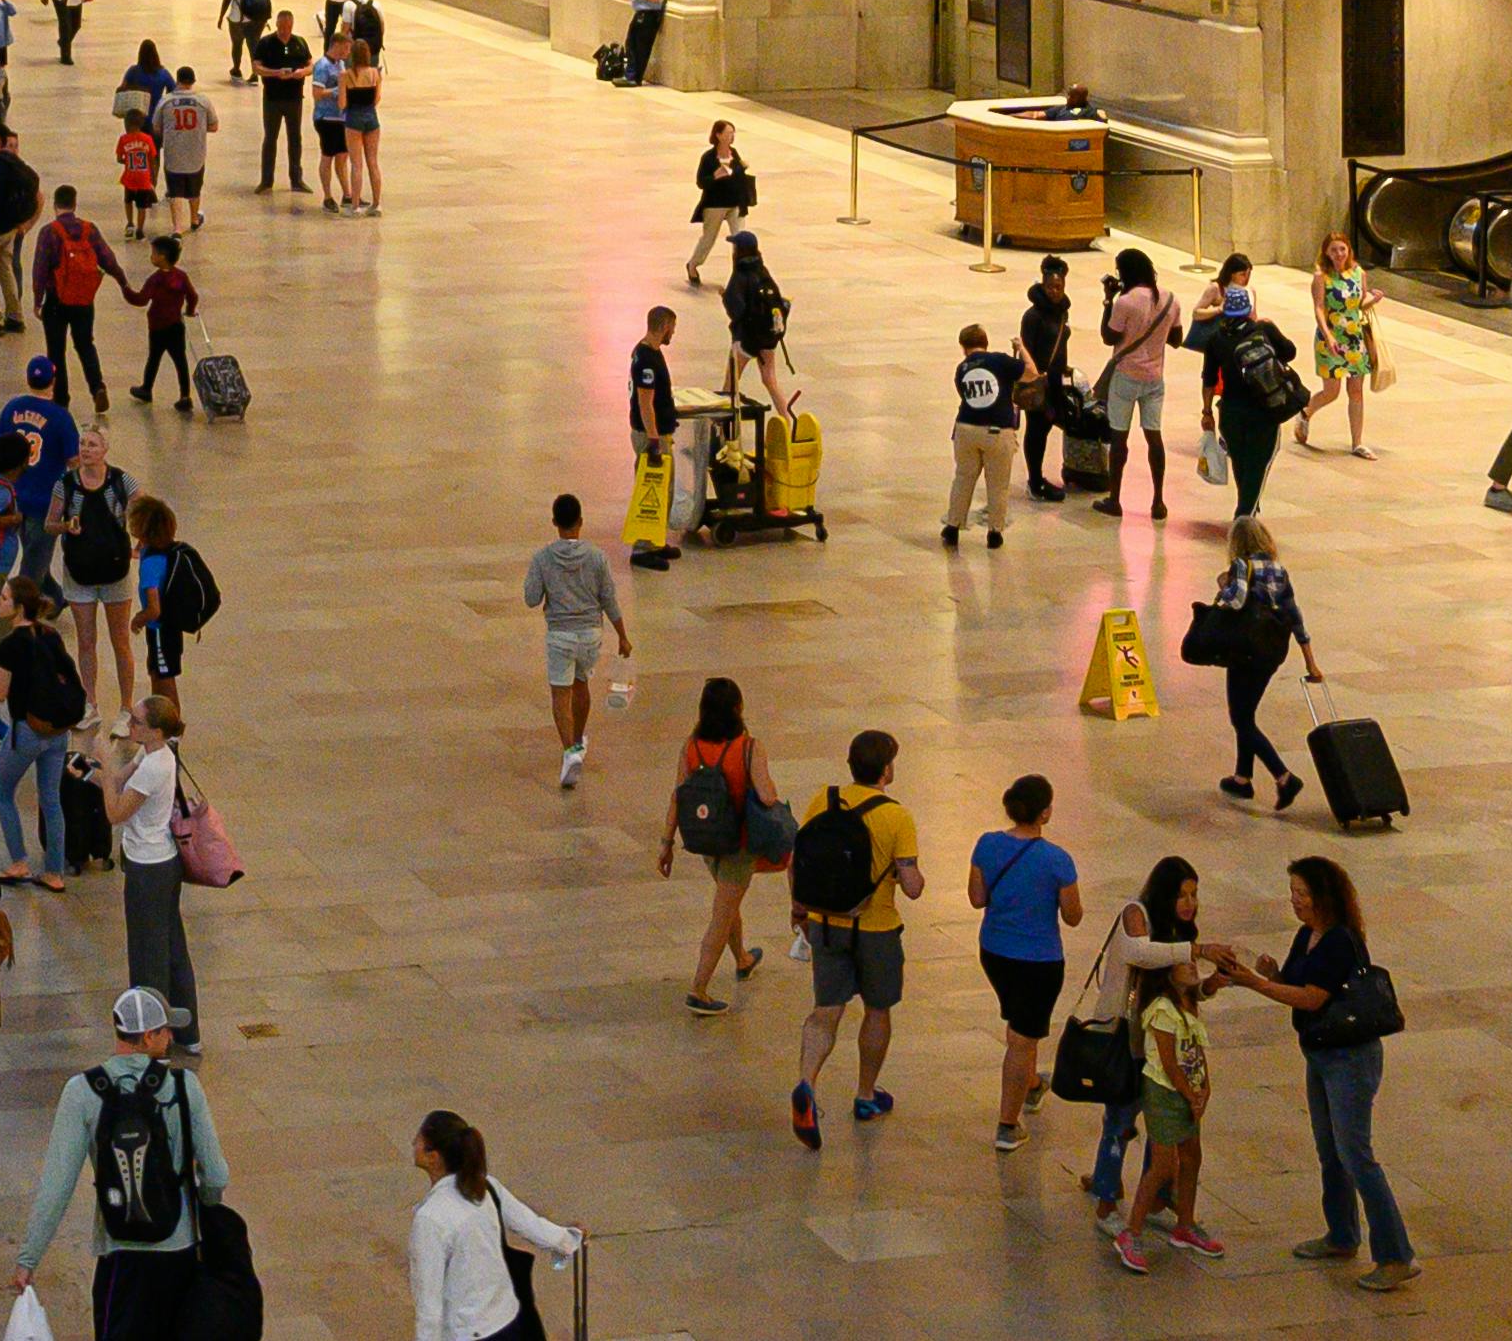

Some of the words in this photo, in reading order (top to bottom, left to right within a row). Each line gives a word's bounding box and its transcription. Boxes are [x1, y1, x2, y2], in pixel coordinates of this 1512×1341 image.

[172, 108, 197, 130] 10
[129, 151, 148, 171] 13
[963, 380, 994, 399] MTA
